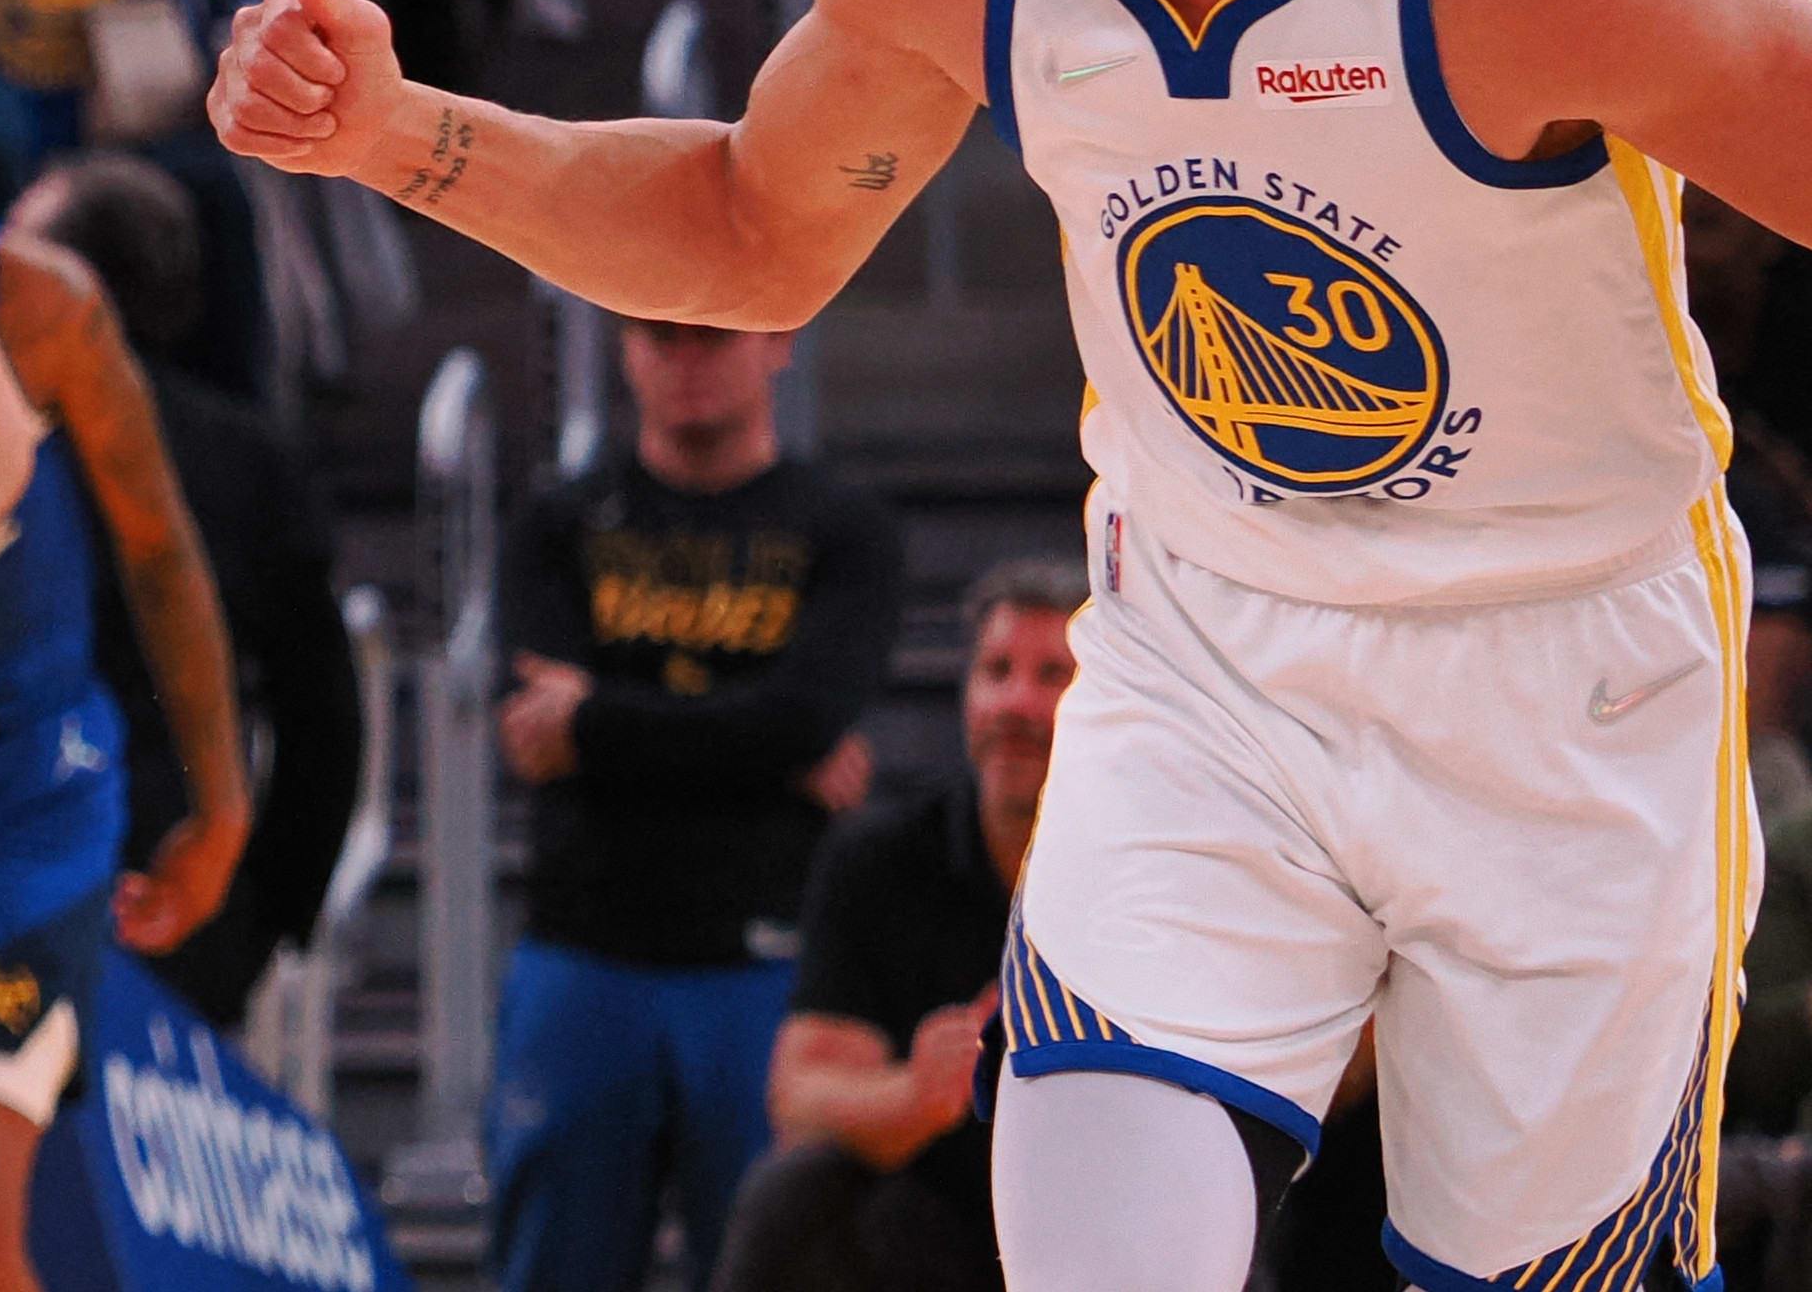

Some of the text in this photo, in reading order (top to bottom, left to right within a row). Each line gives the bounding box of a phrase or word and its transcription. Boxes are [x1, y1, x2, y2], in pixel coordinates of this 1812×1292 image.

[1255, 63, 1387, 103] Rakuten
[1100, 157, 1402, 262] GOLDEN STATE
[1263, 272, 1392, 353] 30
